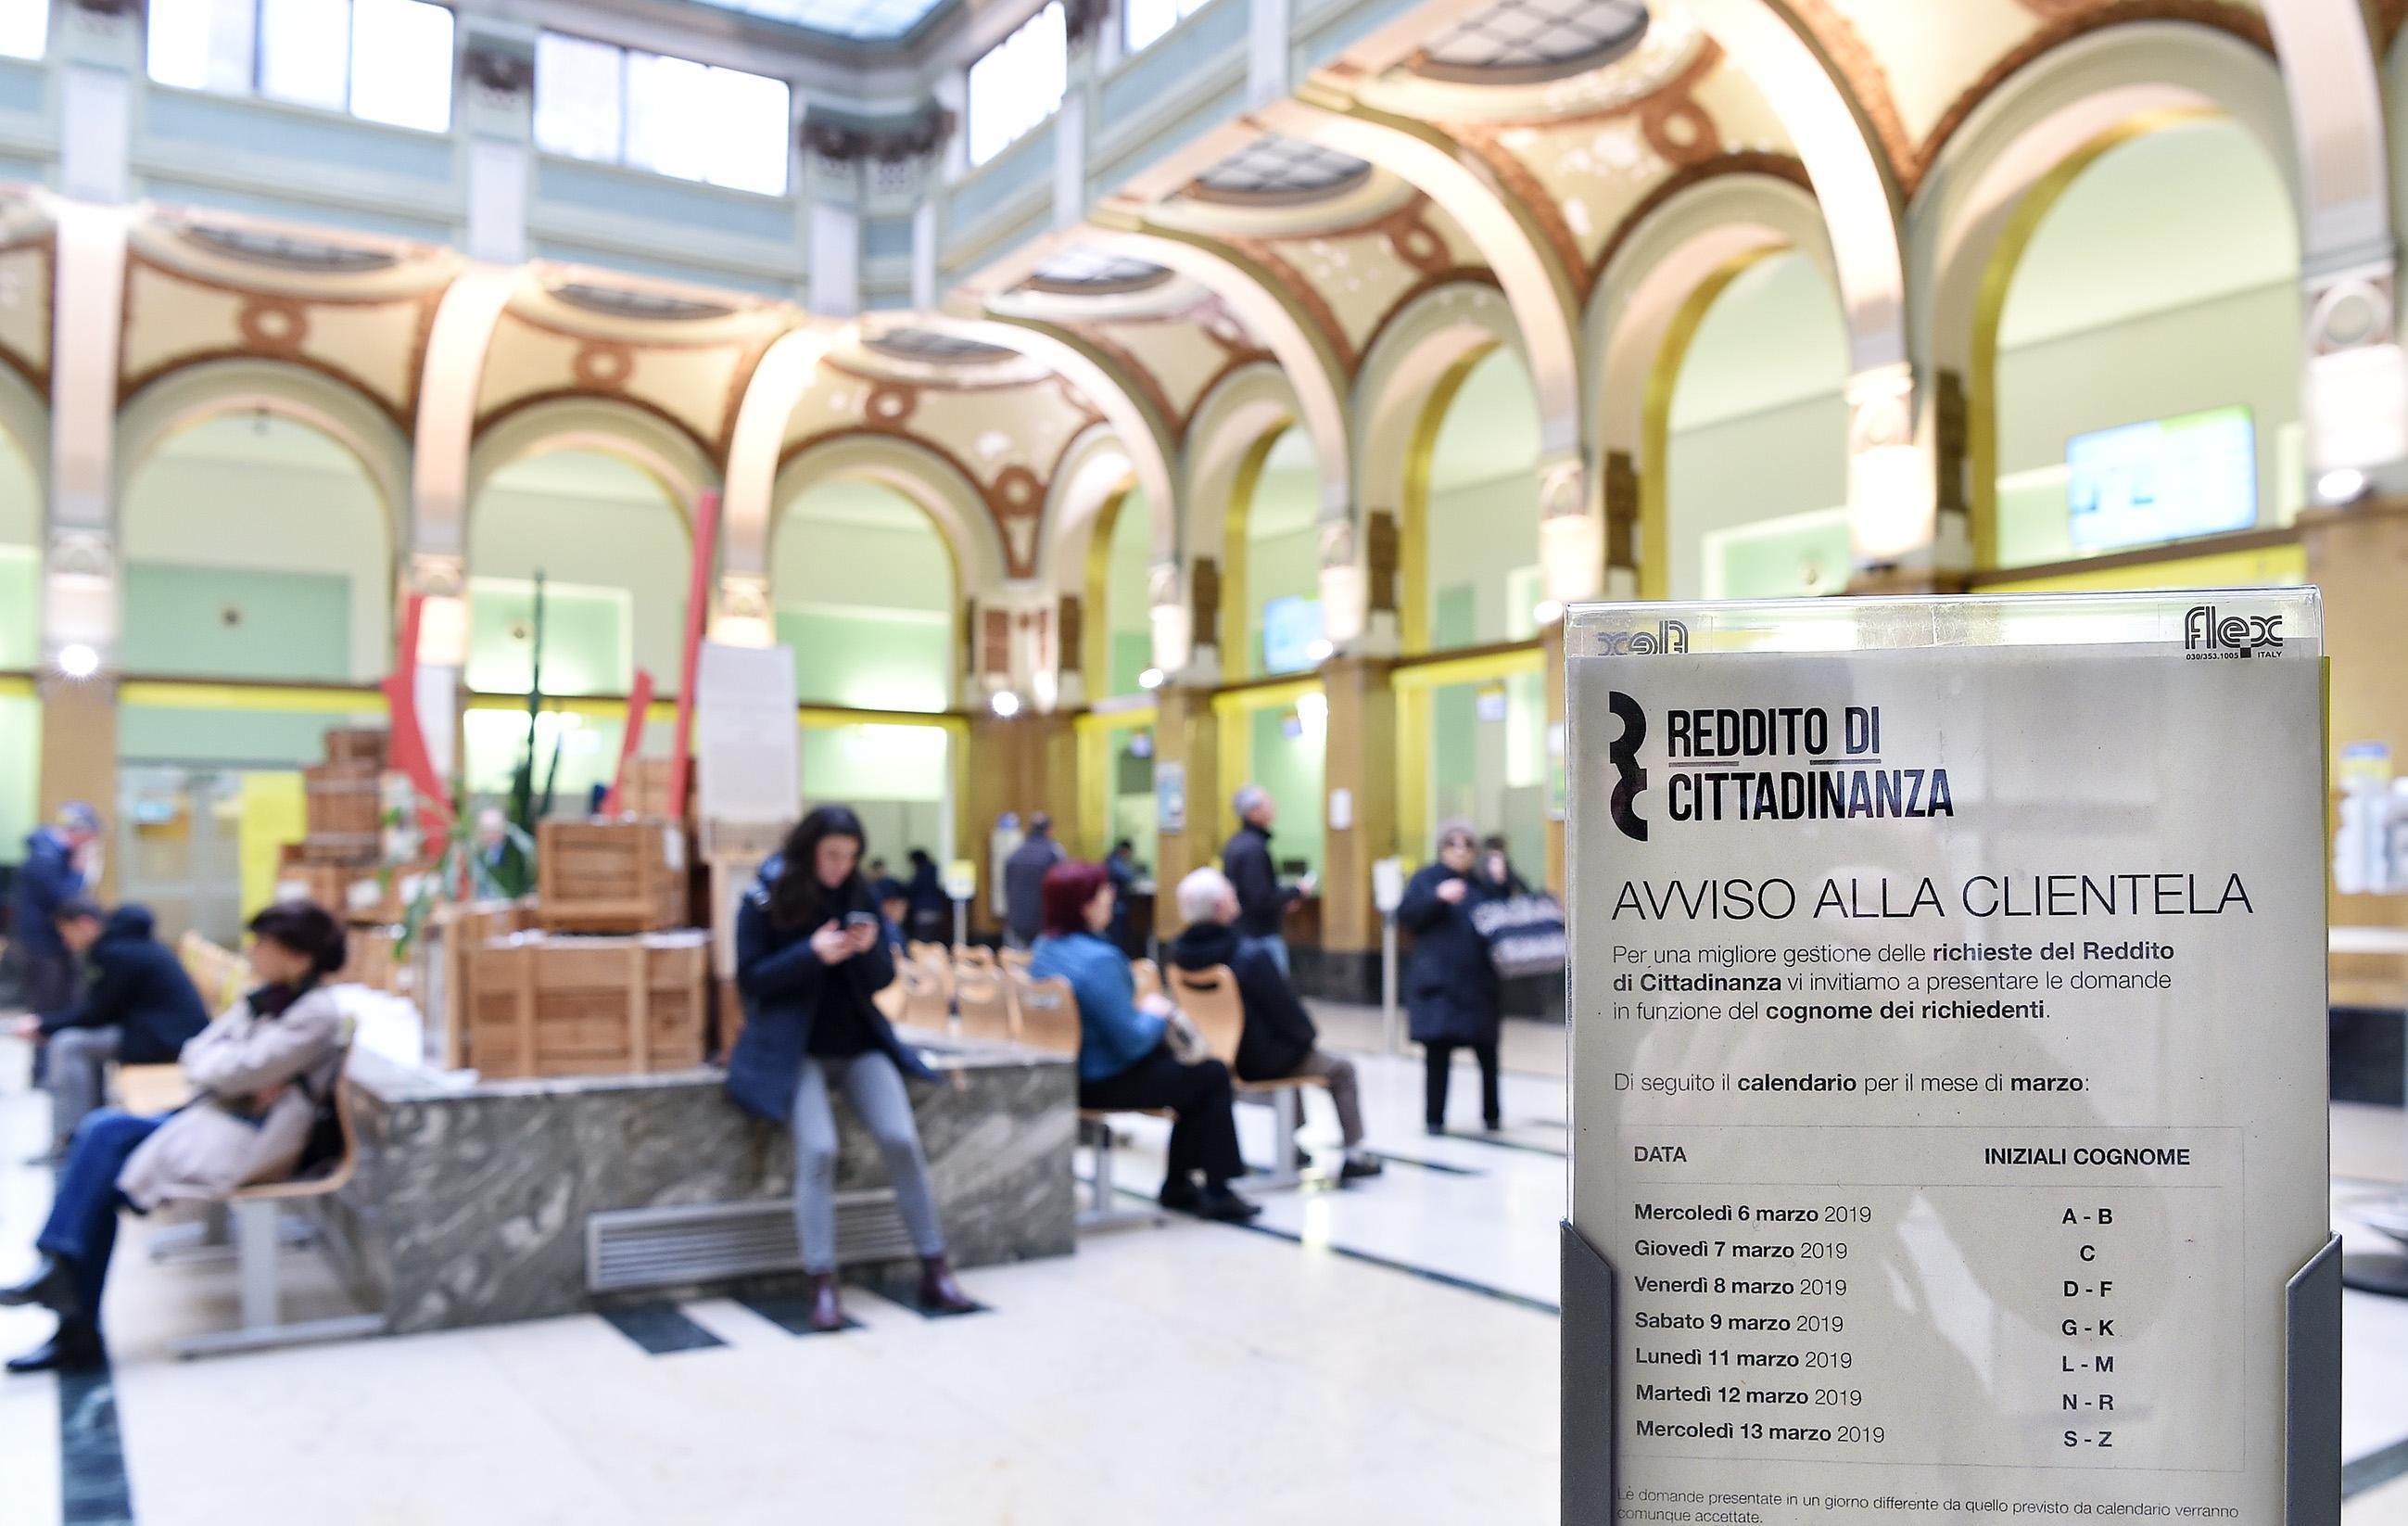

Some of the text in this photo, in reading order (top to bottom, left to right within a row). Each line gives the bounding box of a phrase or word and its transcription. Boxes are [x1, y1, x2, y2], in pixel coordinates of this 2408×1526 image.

[2185, 605, 2284, 649] flex
[2186, 652, 2239, 660] 030/353.1005
[1667, 706, 1880, 758] REDDITO DI
[1668, 768, 1955, 821] CITTADINANZA
[1611, 878, 1796, 921] AVVISO
[1812, 877, 1945, 919] ALLA
[1962, 872, 2254, 918] CLIENTELA
[1613, 940, 2174, 968] Per una migliore gestione delle richieste del Reddito
[1613, 970, 2172, 995] di Cittadinanza vi invitiamo a presentare le domande
[1613, 999, 2050, 1024] in funzione del cognome dei richiedenti.
[1615, 1073, 2089, 1097] Di seguito il calendario per il mese di marzo:
[1634, 1145, 1688, 1163] DATA
[1984, 1147, 2190, 1166] INIZIALI COGNOME
[1634, 1203, 1871, 1223] Mercoledì 6 marzo 2019
[2061, 1207, 2078, 1225] A
[2097, 1208, 2113, 1225] B
[1634, 1239, 1848, 1260] Giovedì 7 marzo 2019
[2079, 1244, 2096, 1262] C
[1634, 1276, 1847, 1296] Venerdì 8 marzo 2019
[2063, 1280, 2079, 1297] D
[2099, 1280, 2113, 1298] F
[1635, 1311, 1844, 1333] Sabato 9 marzo 2019
[2061, 1318, 2078, 1336] G
[2098, 1319, 2115, 1337] K
[1636, 1347, 1853, 1369] Lunedì 11 marzo 2019
[2062, 1354, 2075, 1372] L
[2095, 1355, 2114, 1373] M
[1636, 1384, 1862, 1406] Martedì 12 marzo 2019
[2062, 1393, 2078, 1410] N
[2098, 1393, 2114, 1411] R
[1636, 1419, 1885, 1443] Mercoledì 13 marzo 2019
[2063, 1430, 2078, 1448] S
[2097, 1431, 2113, 1448] Z
[1638, 1488, 1705, 1504] domande
[1708, 1493, 1782, 1507] presentate
[1786, 1495, 1798, 1506] in
[1803, 1495, 1820, 1507] un
[1824, 1496, 1869, 1510] giorno
[1872, 1495, 1939, 1511] differente
[1943, 1497, 1961, 1511] da
[1965, 1498, 2009, 1514] quello
[2012, 1500, 2070, 1516] previsto
[2073, 1501, 2092, 1515] da
[2096, 1501, 2171, 1517] calendario
[2174, 1506, 2239, 1519] verranno
[1616, 1508, 1764, 1524] comunque accettate.
